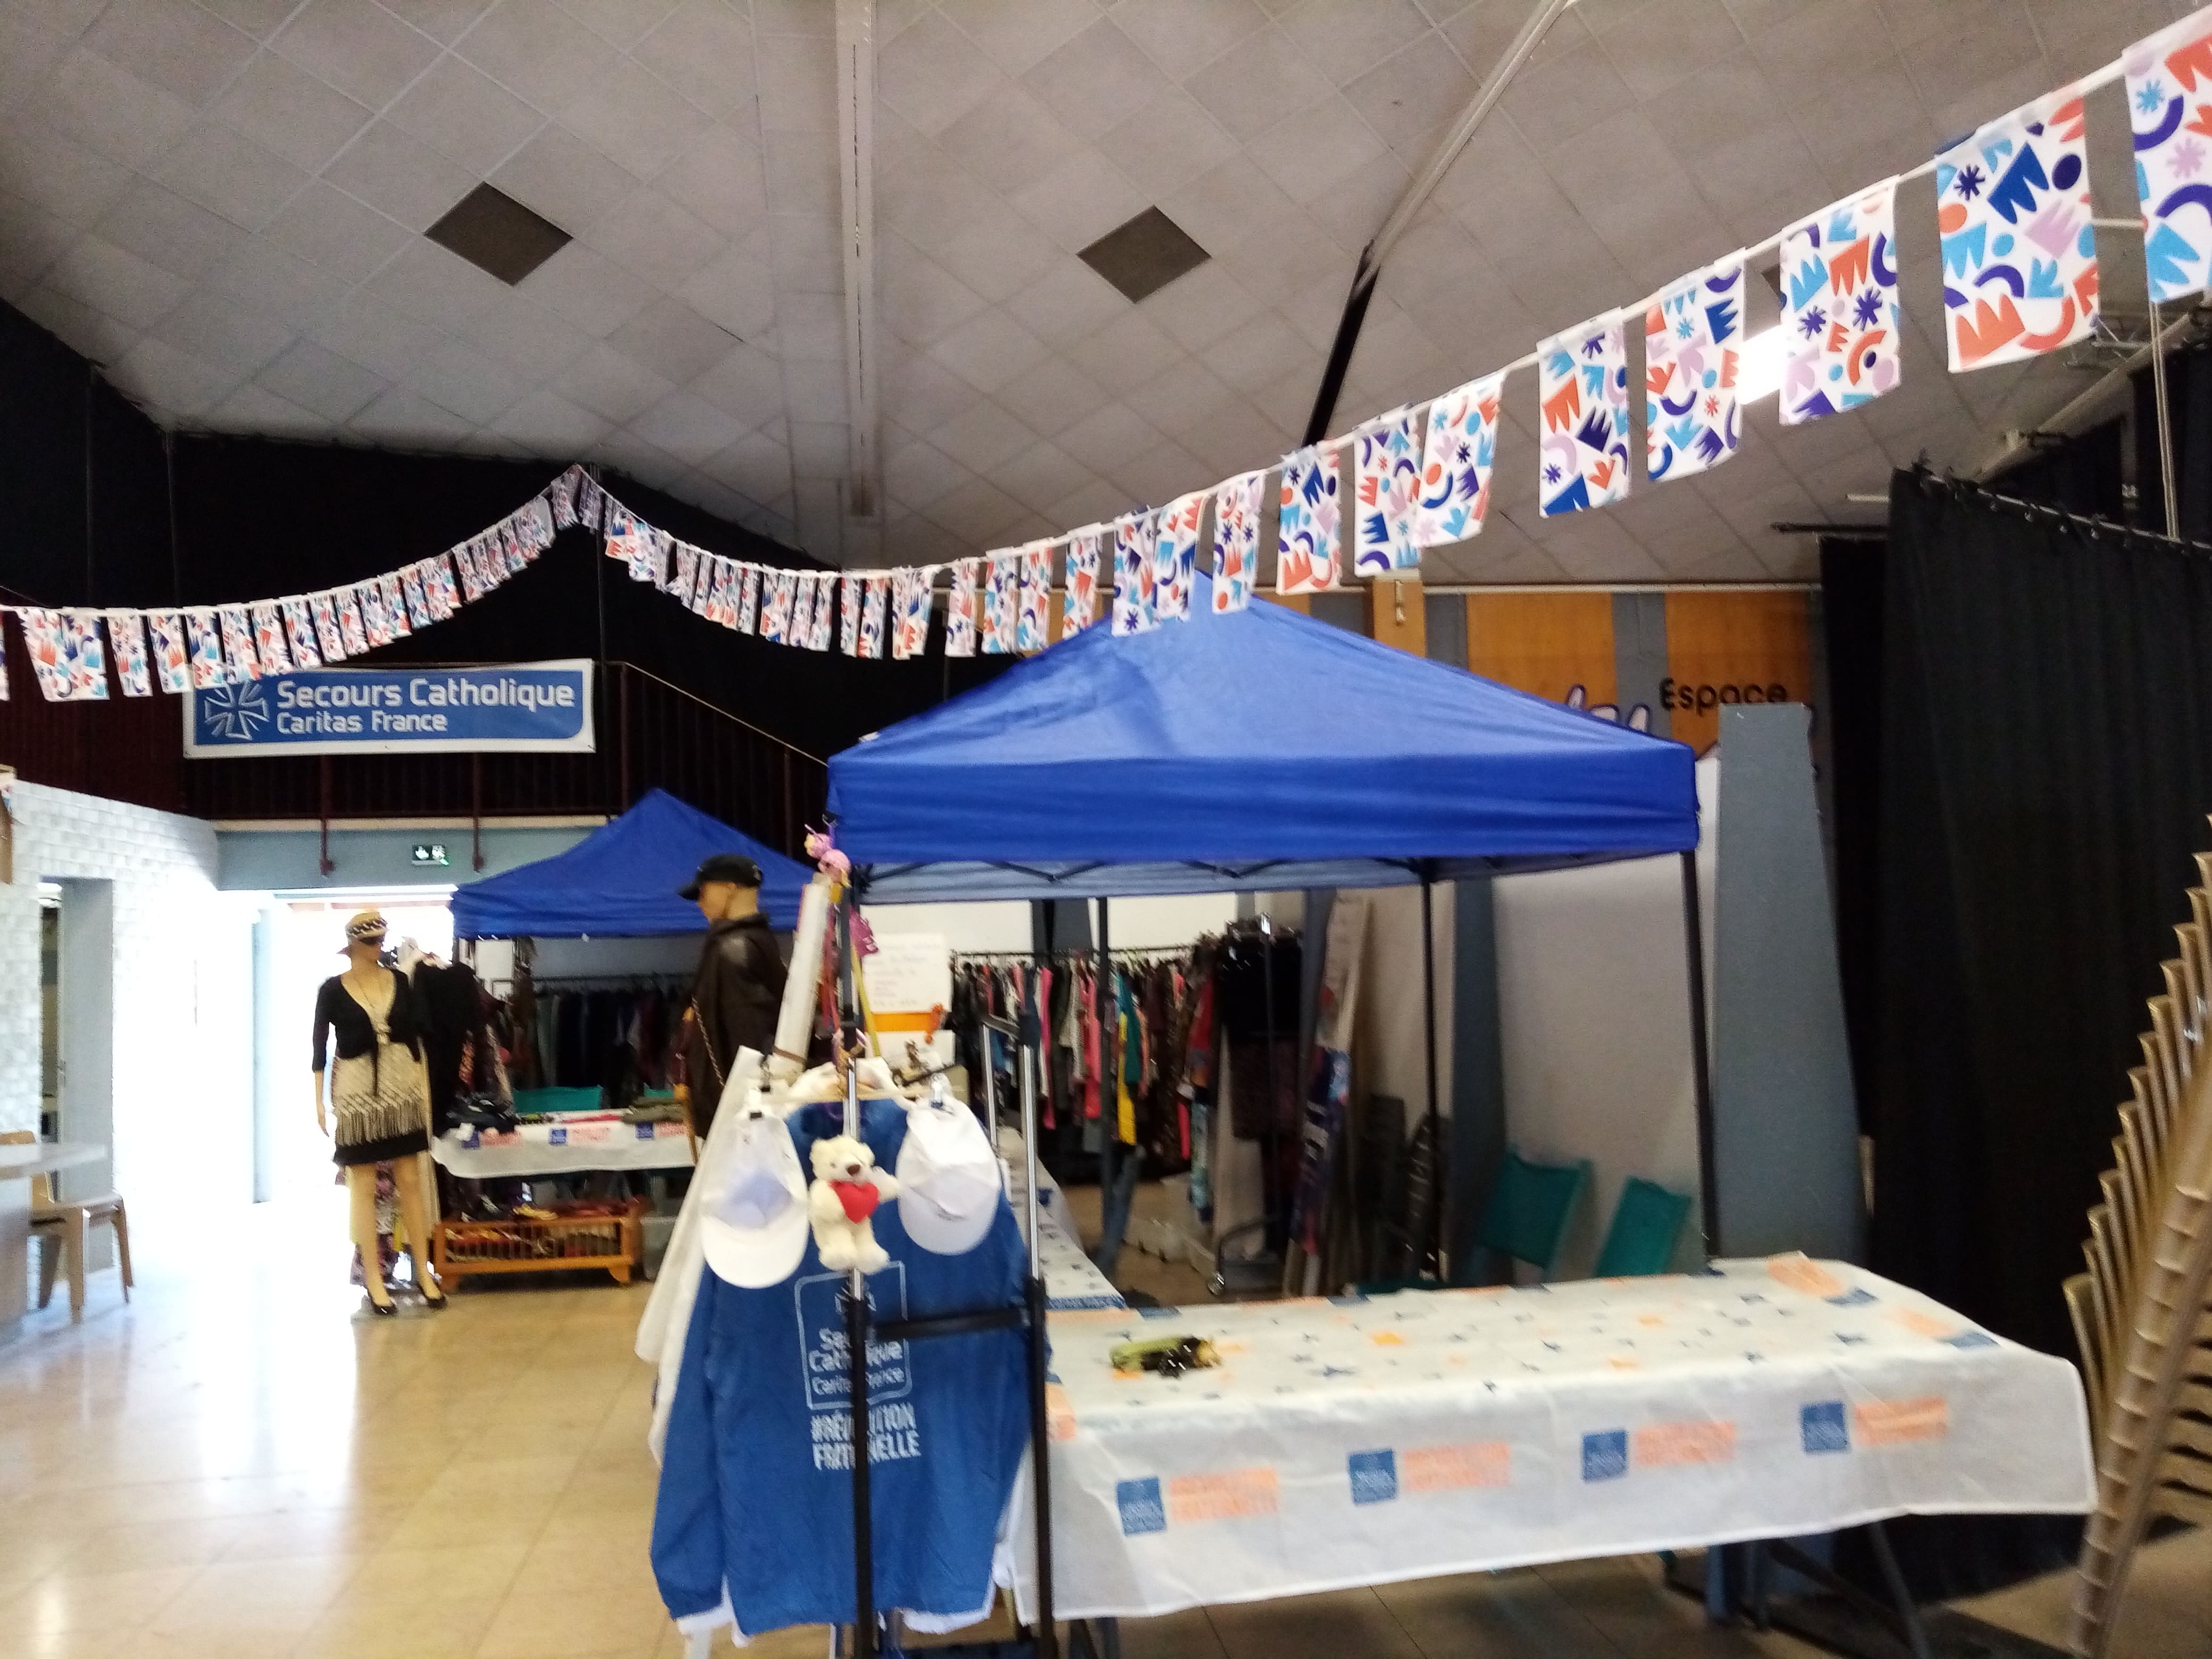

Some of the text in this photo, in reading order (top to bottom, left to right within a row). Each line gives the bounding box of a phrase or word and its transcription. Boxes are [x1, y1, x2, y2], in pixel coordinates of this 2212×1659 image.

[277, 677, 575, 713] Secours Catholique
[1659, 677, 1787, 716] Espace
[276, 710, 448, 734] Caritas France
